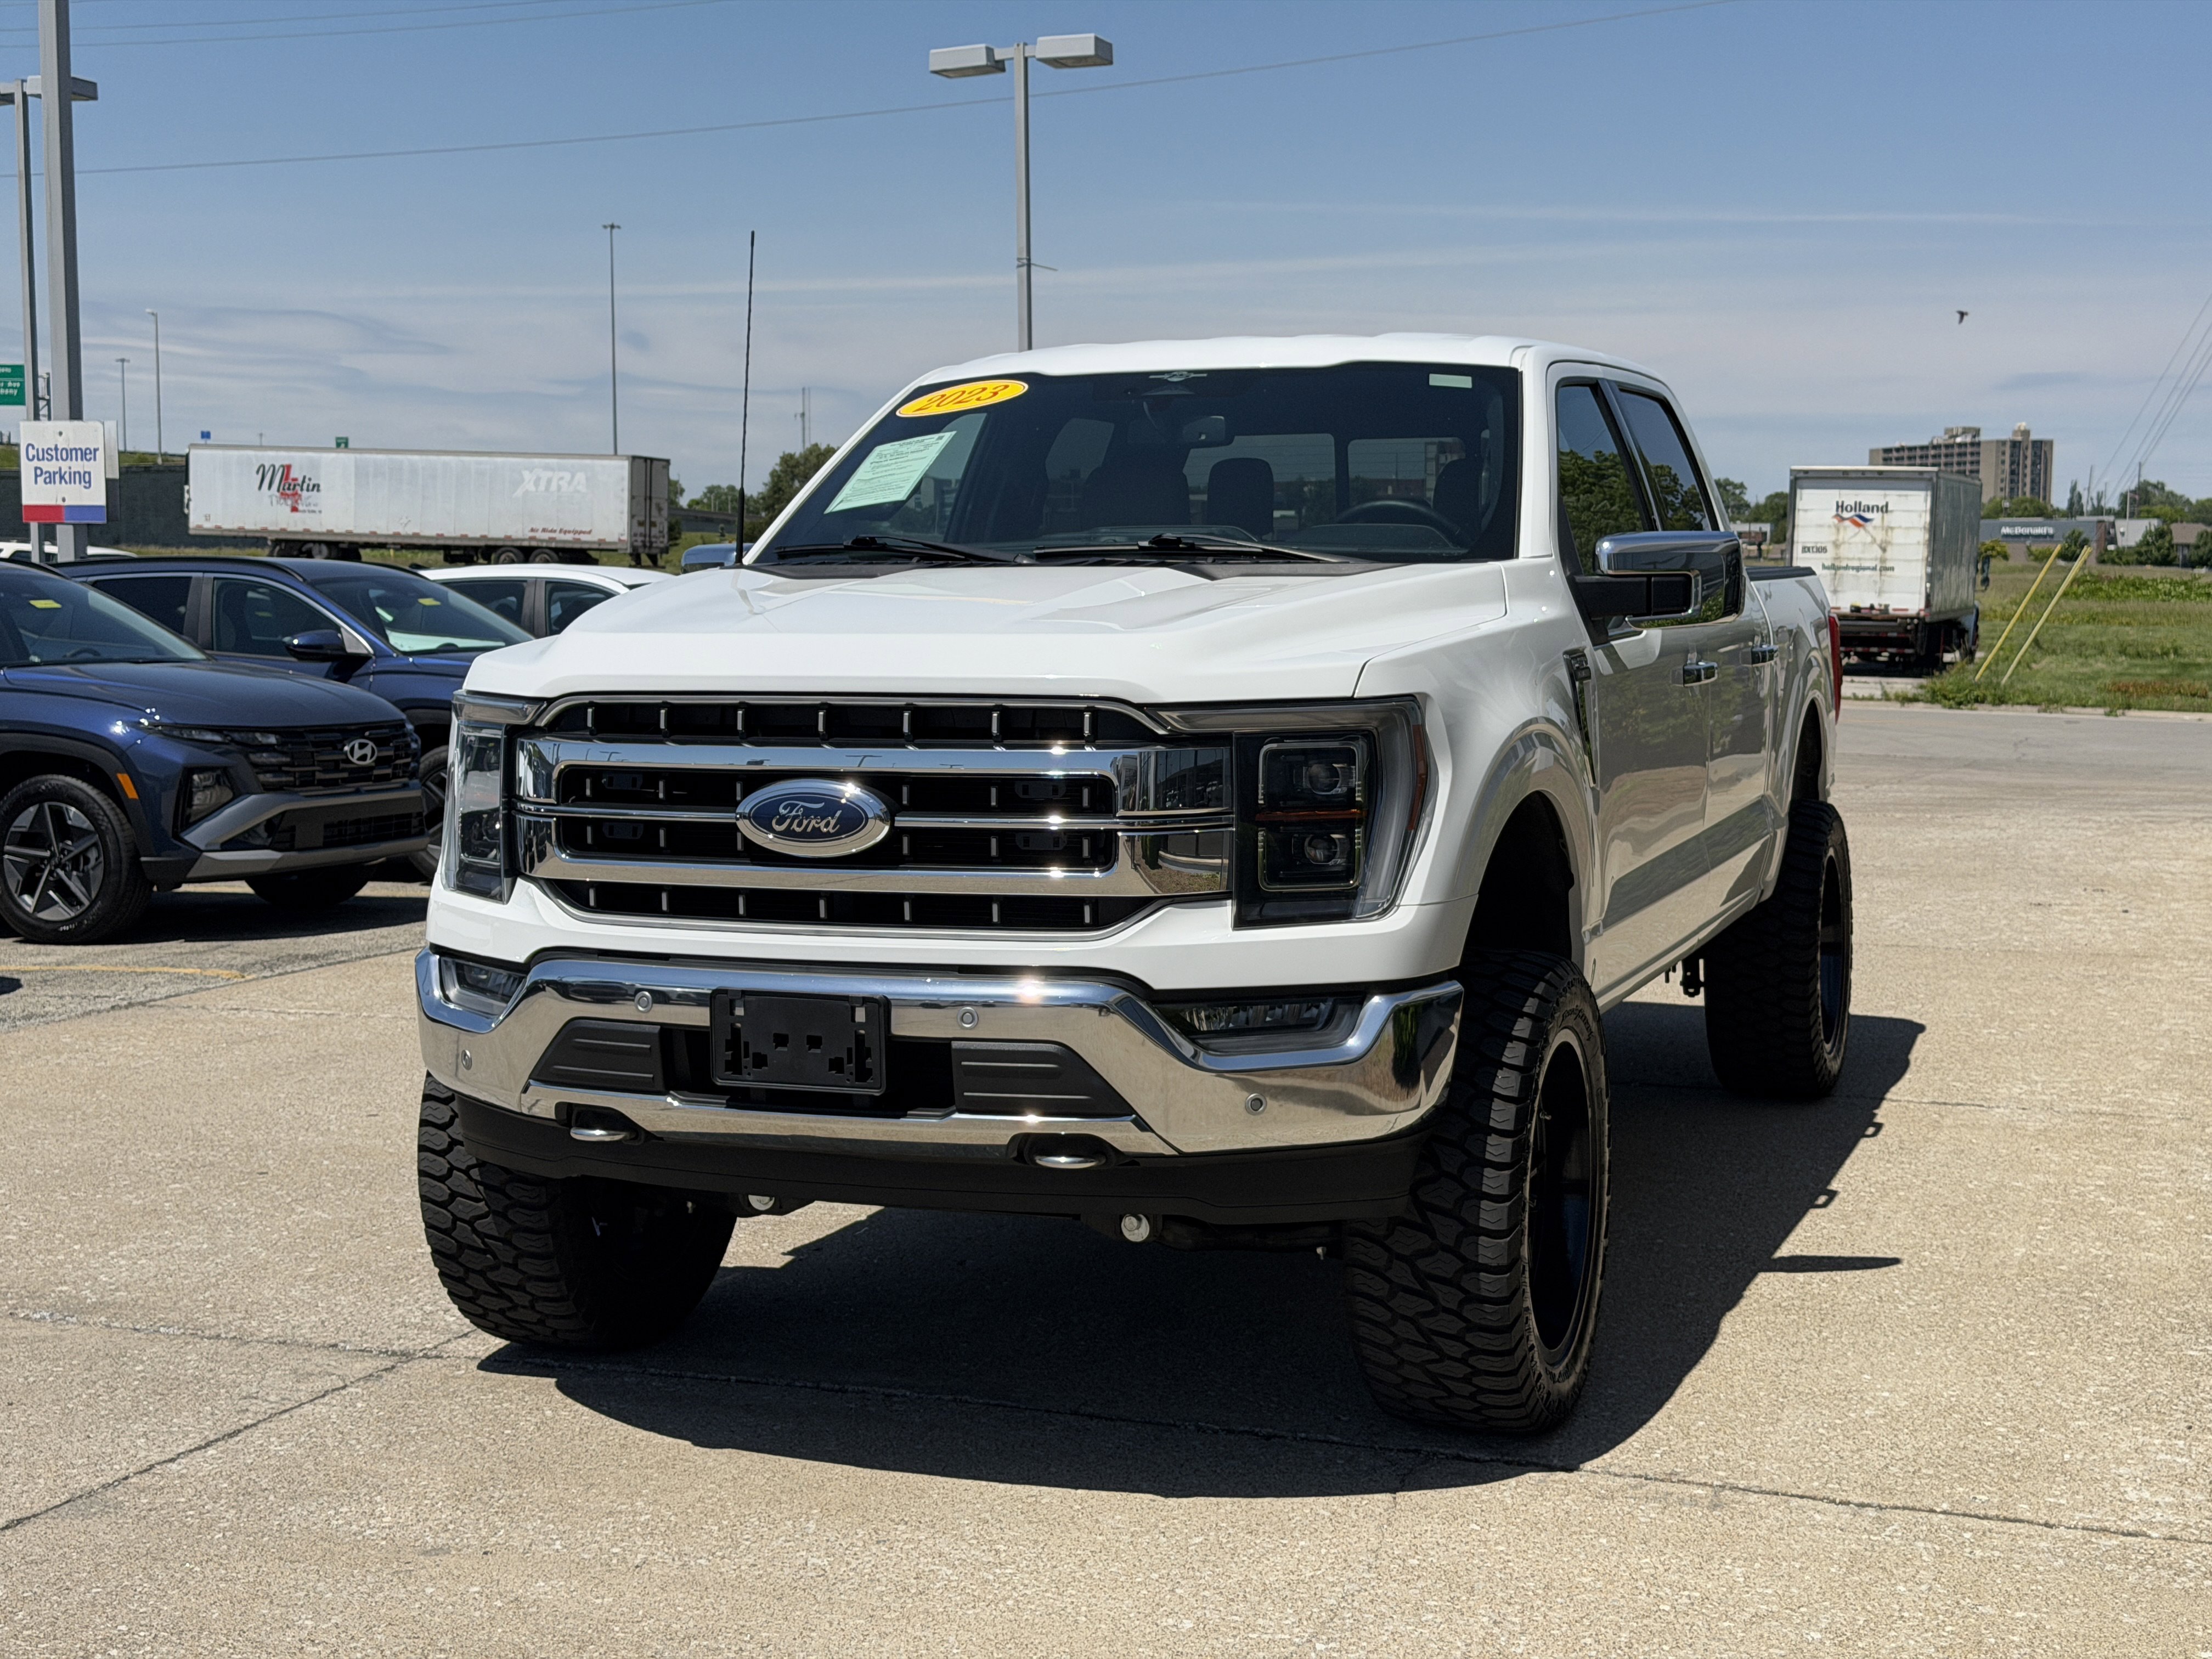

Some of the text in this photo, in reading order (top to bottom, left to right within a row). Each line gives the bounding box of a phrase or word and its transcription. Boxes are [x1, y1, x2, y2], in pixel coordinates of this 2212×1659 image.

[912, 385, 1010, 413] 2023
[25, 443, 100, 462] Customer
[34, 466, 92, 489] Parking
[256, 464, 321, 493] Martin
[512, 468, 588, 498] XTRA
[1835, 500, 1889, 514] Holland
[772, 800, 842, 833] Ford
